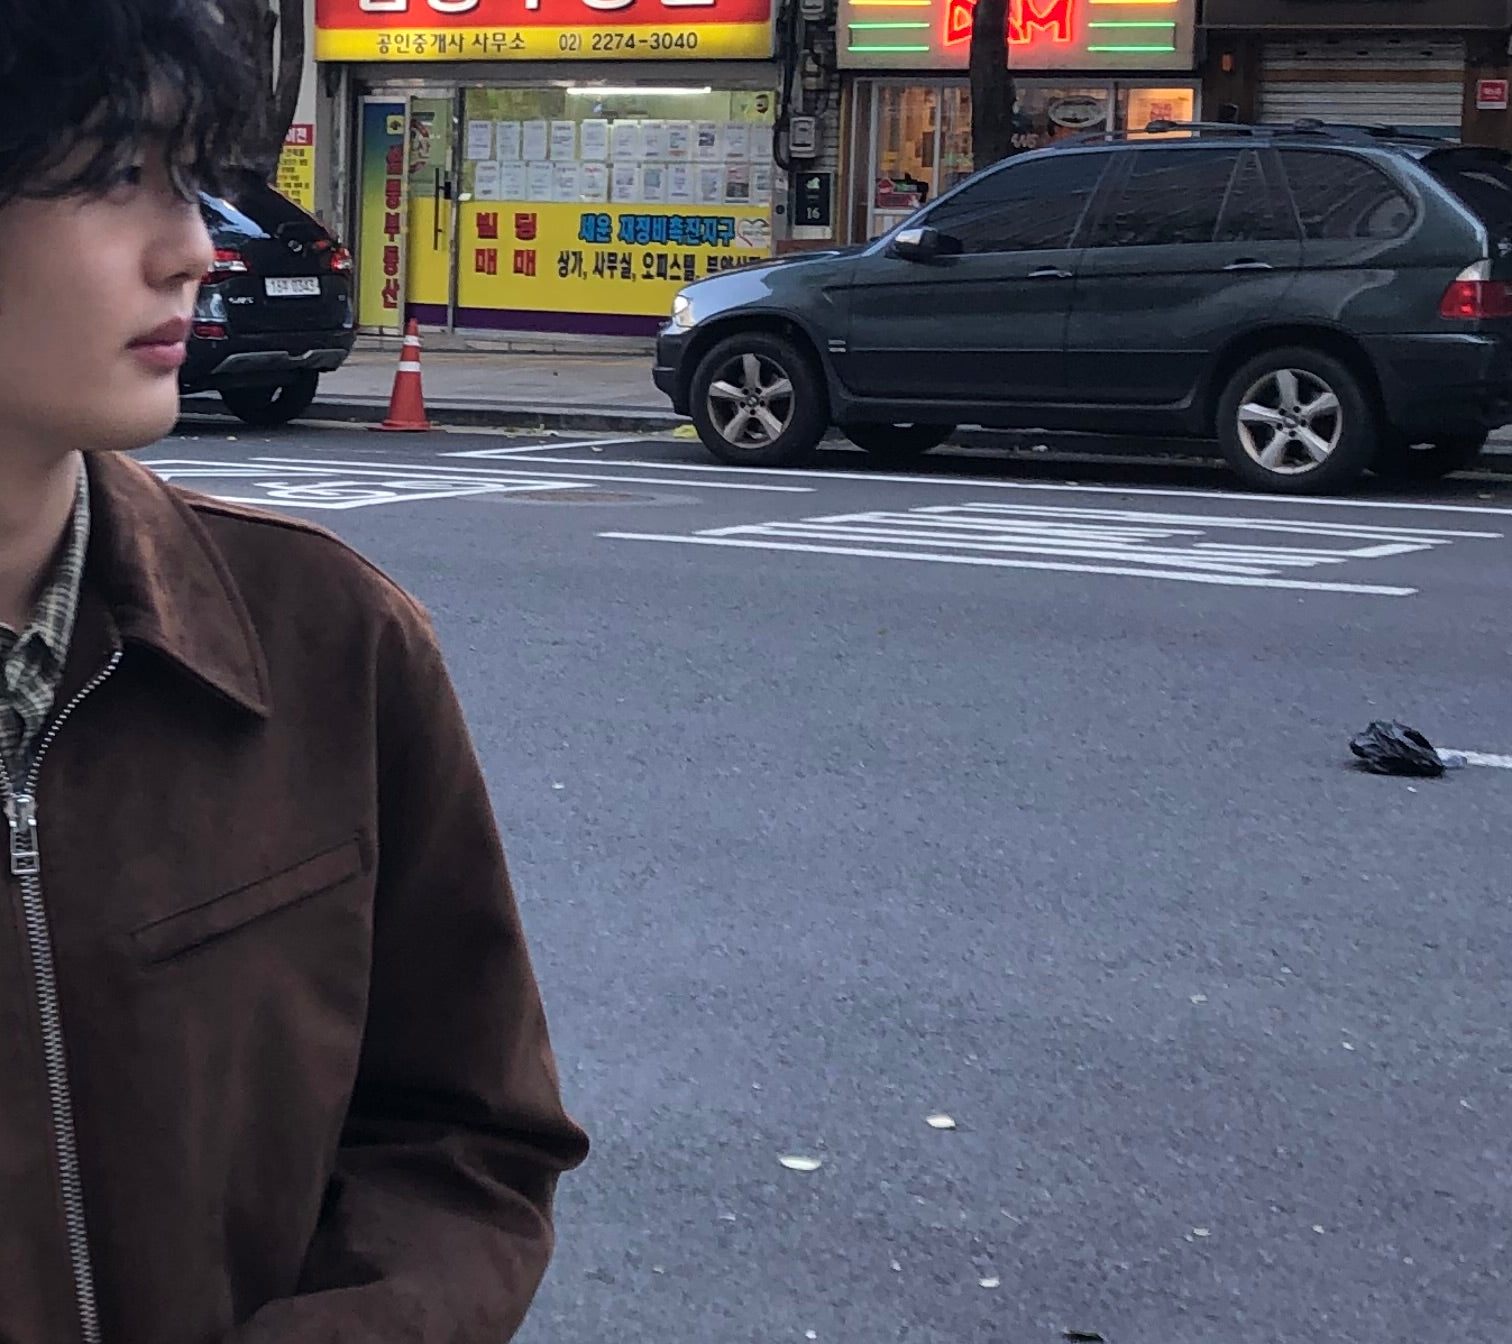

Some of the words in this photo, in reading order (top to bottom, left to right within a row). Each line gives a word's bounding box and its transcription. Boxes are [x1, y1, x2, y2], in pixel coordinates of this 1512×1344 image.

[376, 32, 465, 55] 공인중개사
[471, 32, 526, 53] 사무소
[592, 32, 698, 50] 2274-3040
[807, 207, 820, 220] 16
[578, 213, 613, 244] 세운
[475, 248, 537, 277] 매매
[557, 250, 587, 280] 상가,
[593, 251, 636, 281] 사무실,
